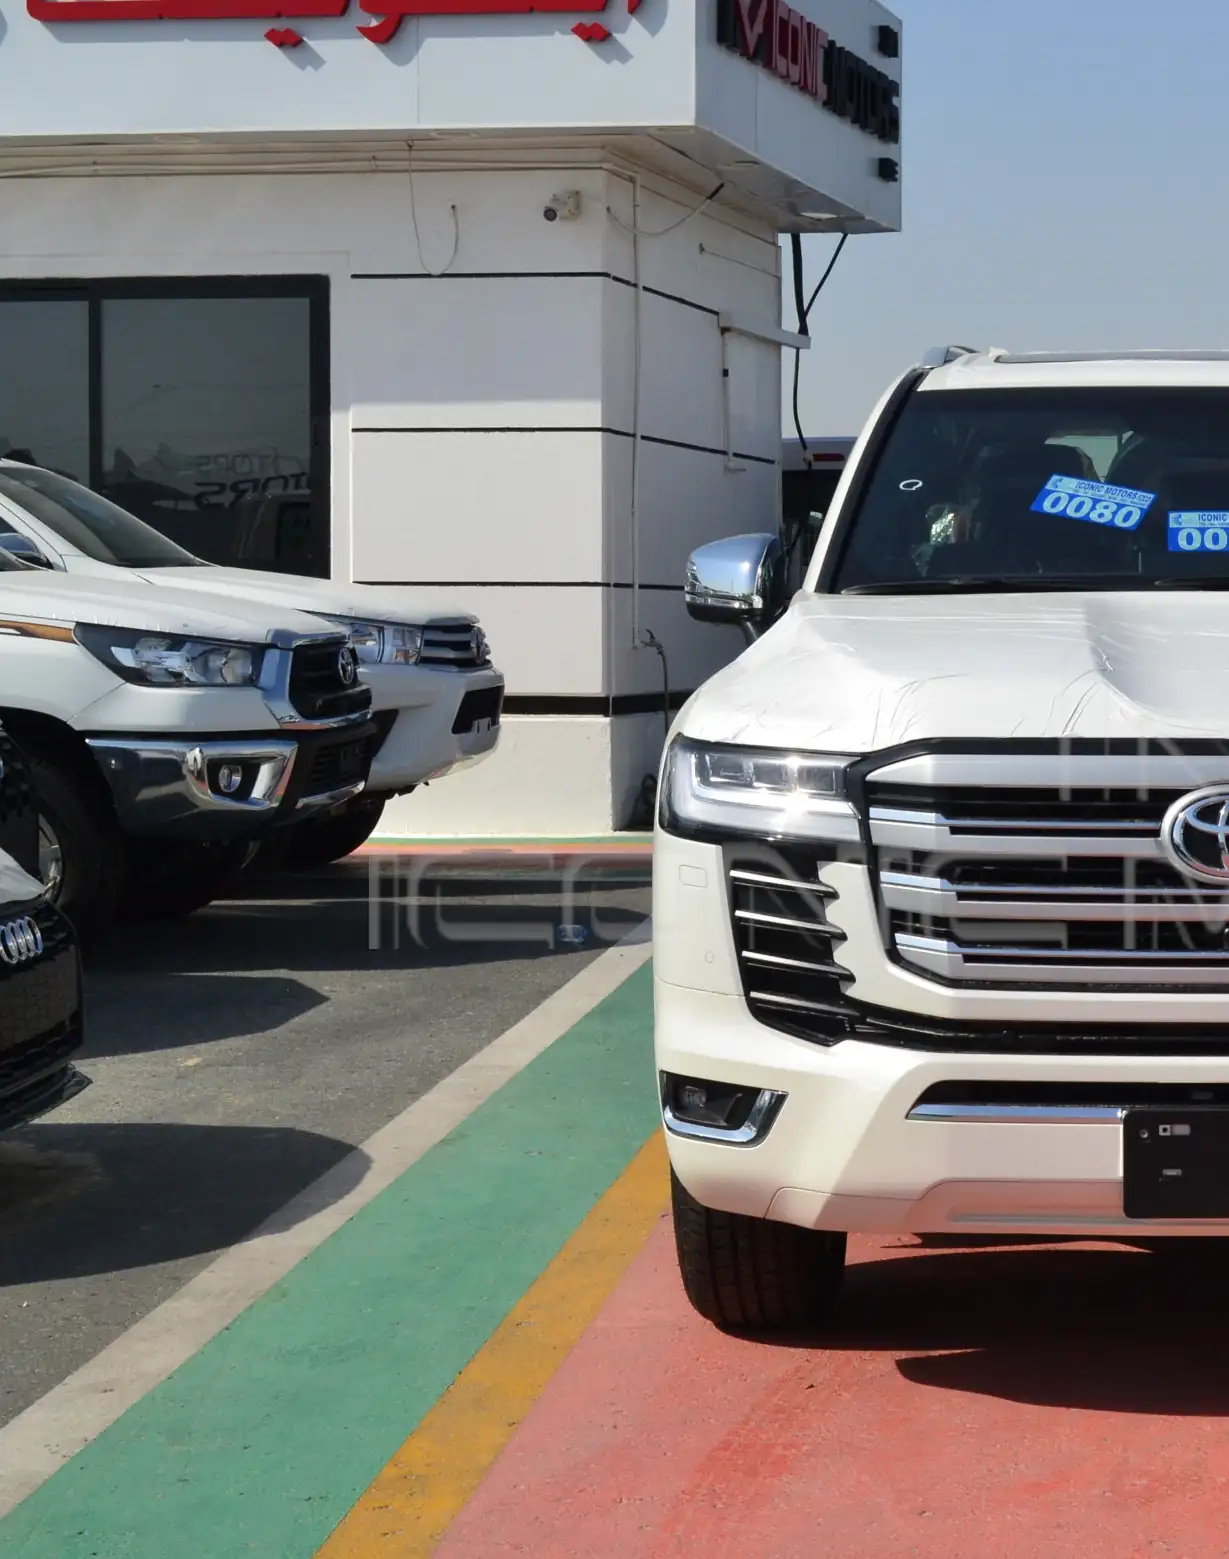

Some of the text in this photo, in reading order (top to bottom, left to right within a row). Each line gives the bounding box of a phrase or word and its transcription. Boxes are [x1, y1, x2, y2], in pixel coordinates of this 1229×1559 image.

[1075, 480, 1104, 493] ICONIC
[1104, 487, 1137, 499] MOTORS
[1042, 491, 1141, 528] 0080
[1198, 513, 1228, 522] ICONIC
